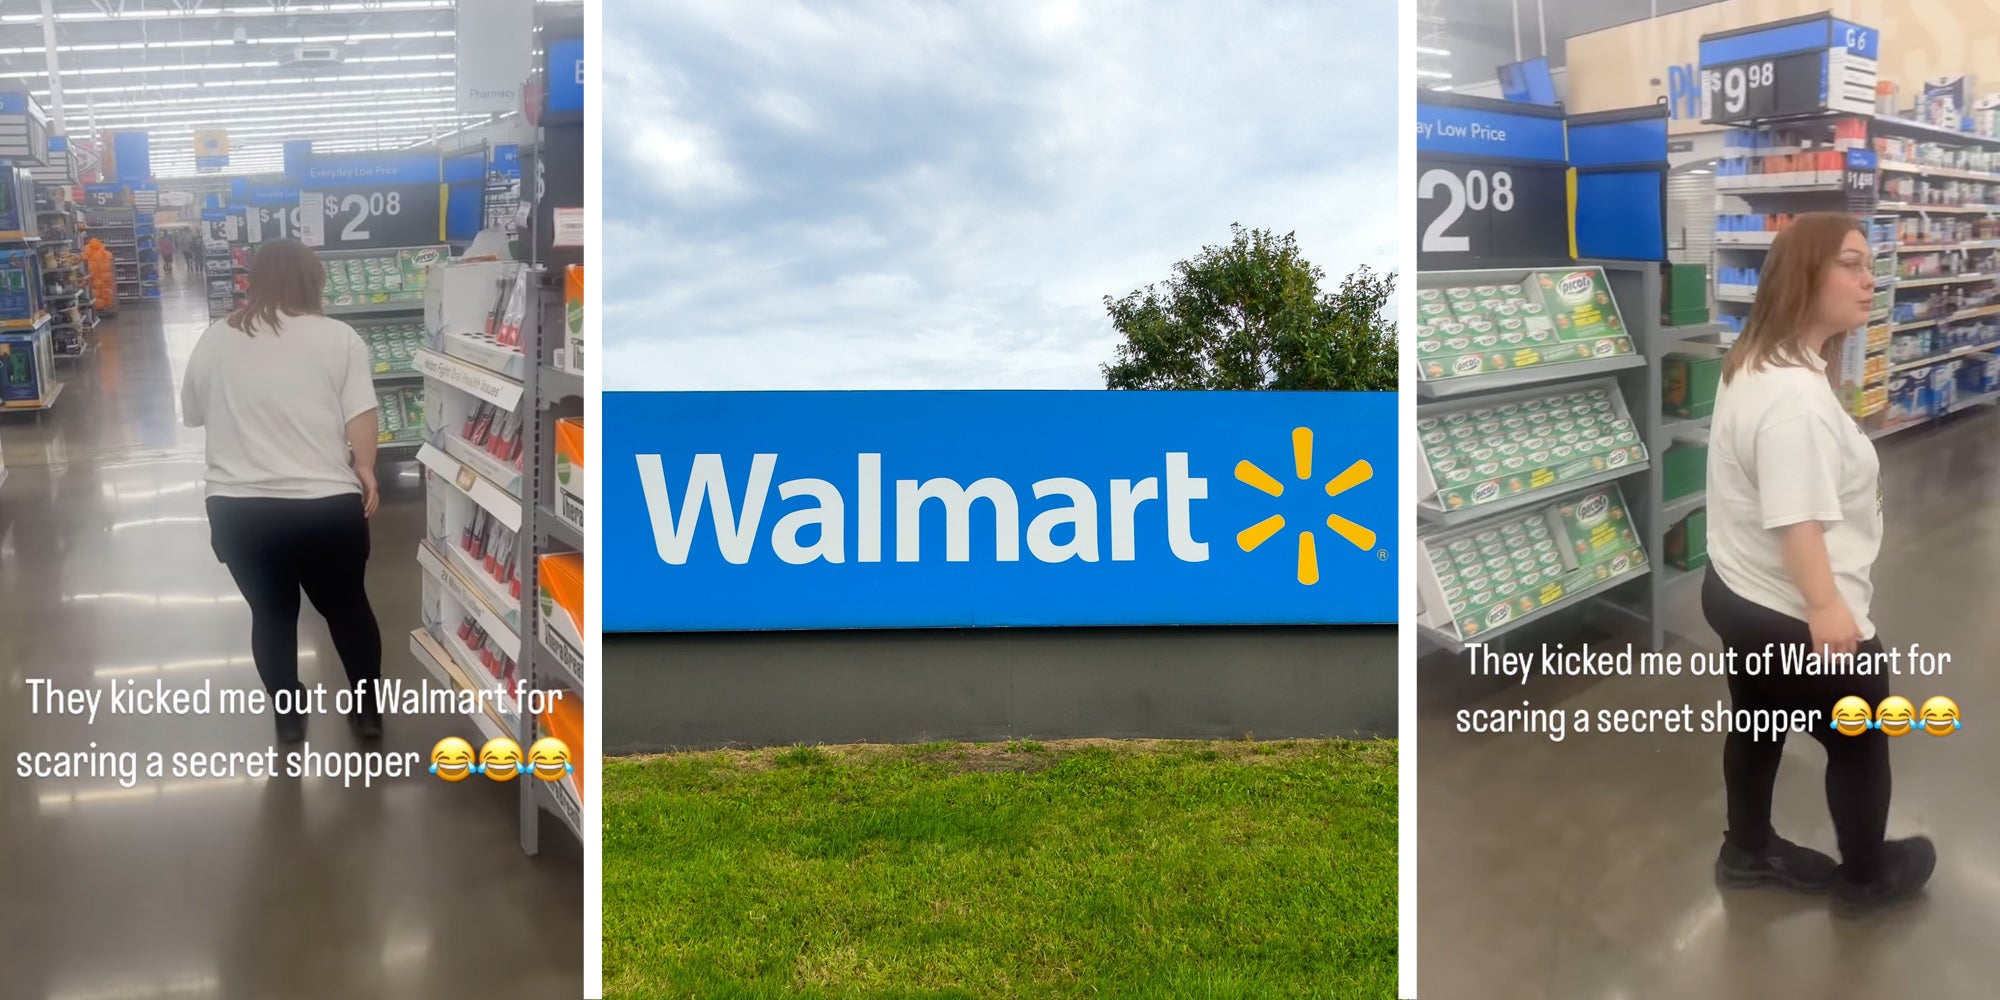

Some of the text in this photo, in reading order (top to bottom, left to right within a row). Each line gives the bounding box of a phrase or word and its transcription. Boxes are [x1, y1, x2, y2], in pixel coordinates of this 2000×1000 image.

[470, 88, 516, 101] Pharmacy
[1437, 120, 1466, 138] Low
[1472, 123, 1507, 142] Price
[310, 165, 399, 180] Everyday Low Price
[634, 452, 1209, 565] Walmart
